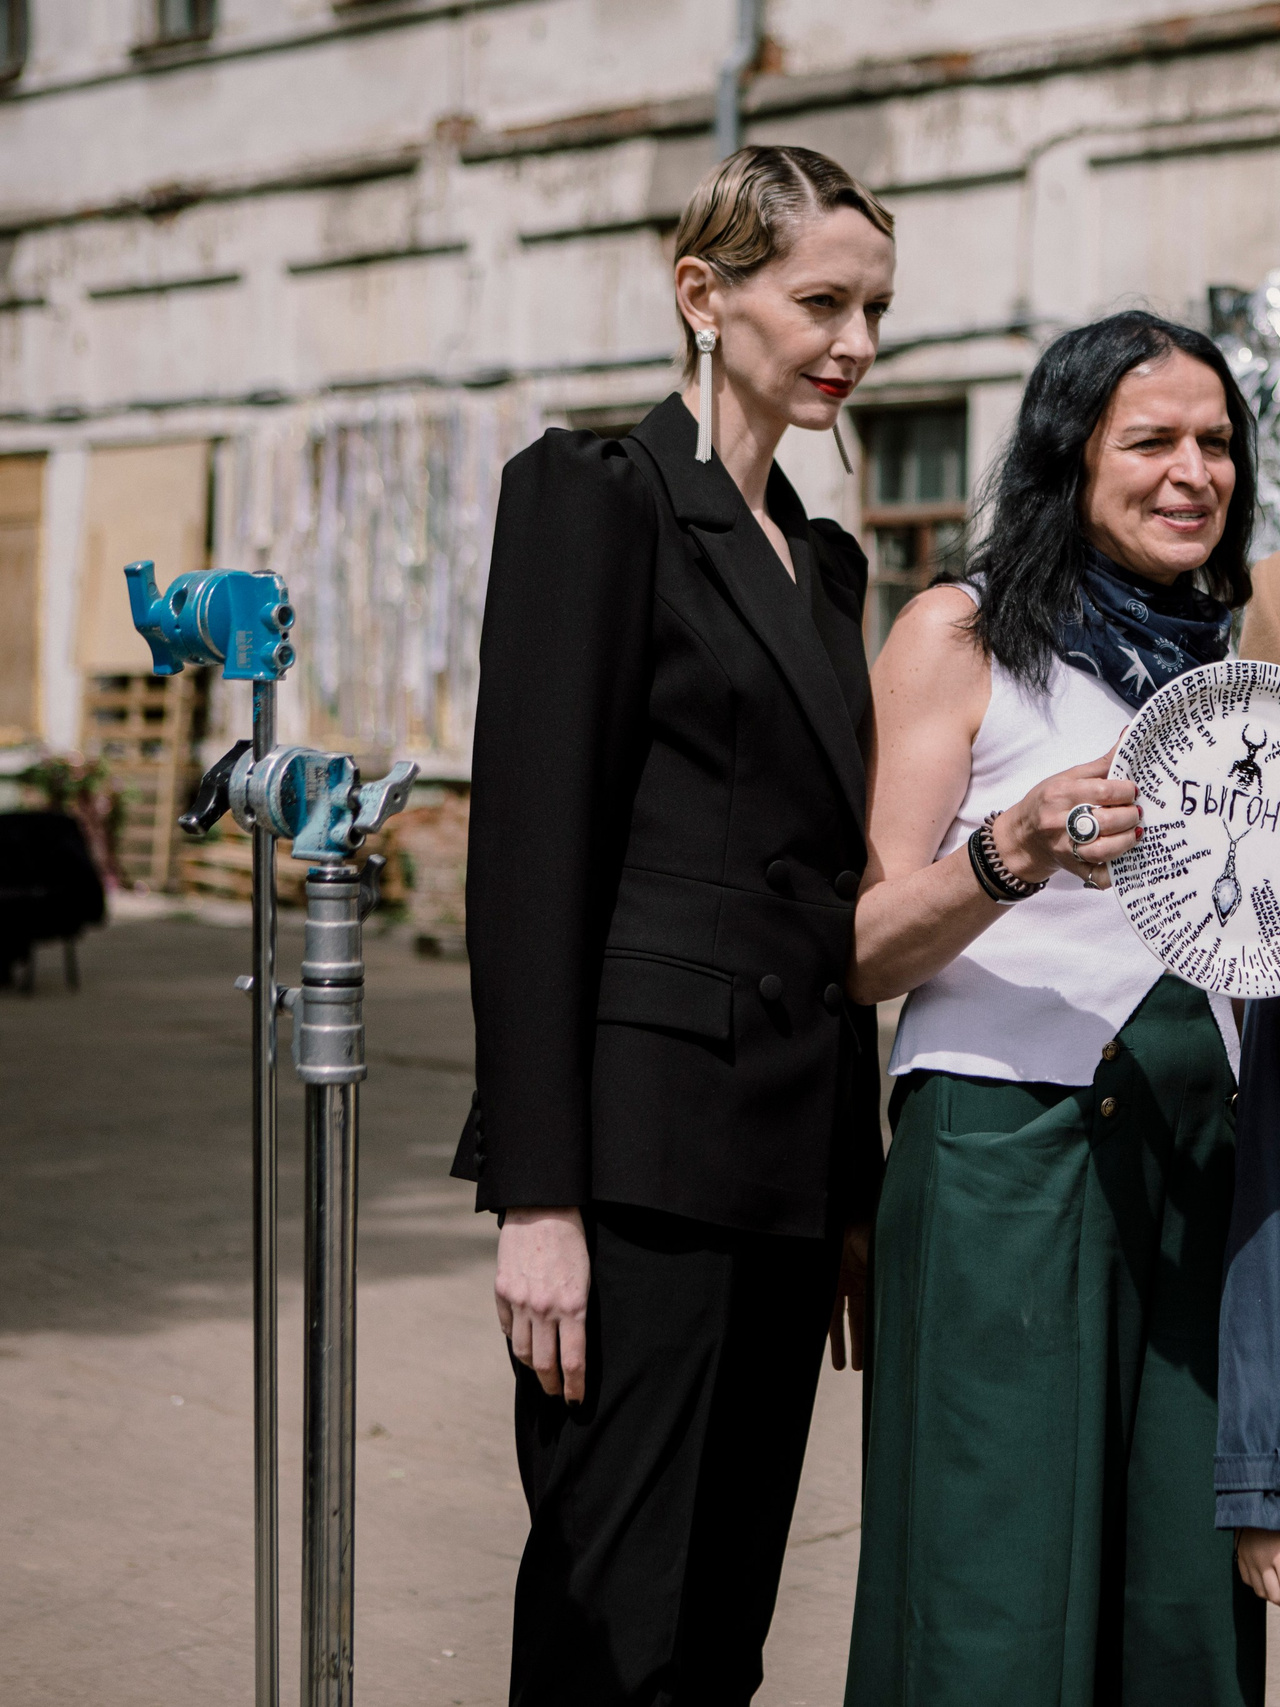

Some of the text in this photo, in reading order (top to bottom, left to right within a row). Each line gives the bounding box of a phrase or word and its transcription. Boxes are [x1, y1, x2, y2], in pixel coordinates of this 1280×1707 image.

[1225, 663, 1233, 686] АННА
[1181, 676, 1217, 747] ВЕРА ШТЕРН
[1142, 756, 1163, 787] ТРОЯН
[1140, 786, 1166, 809] ОСИПОВ
[1143, 820, 1186, 835] РЕБРЯКОВ
[1149, 891, 1175, 910] КРИГЕР
[1224, 957, 1237, 991] МЫШКА
